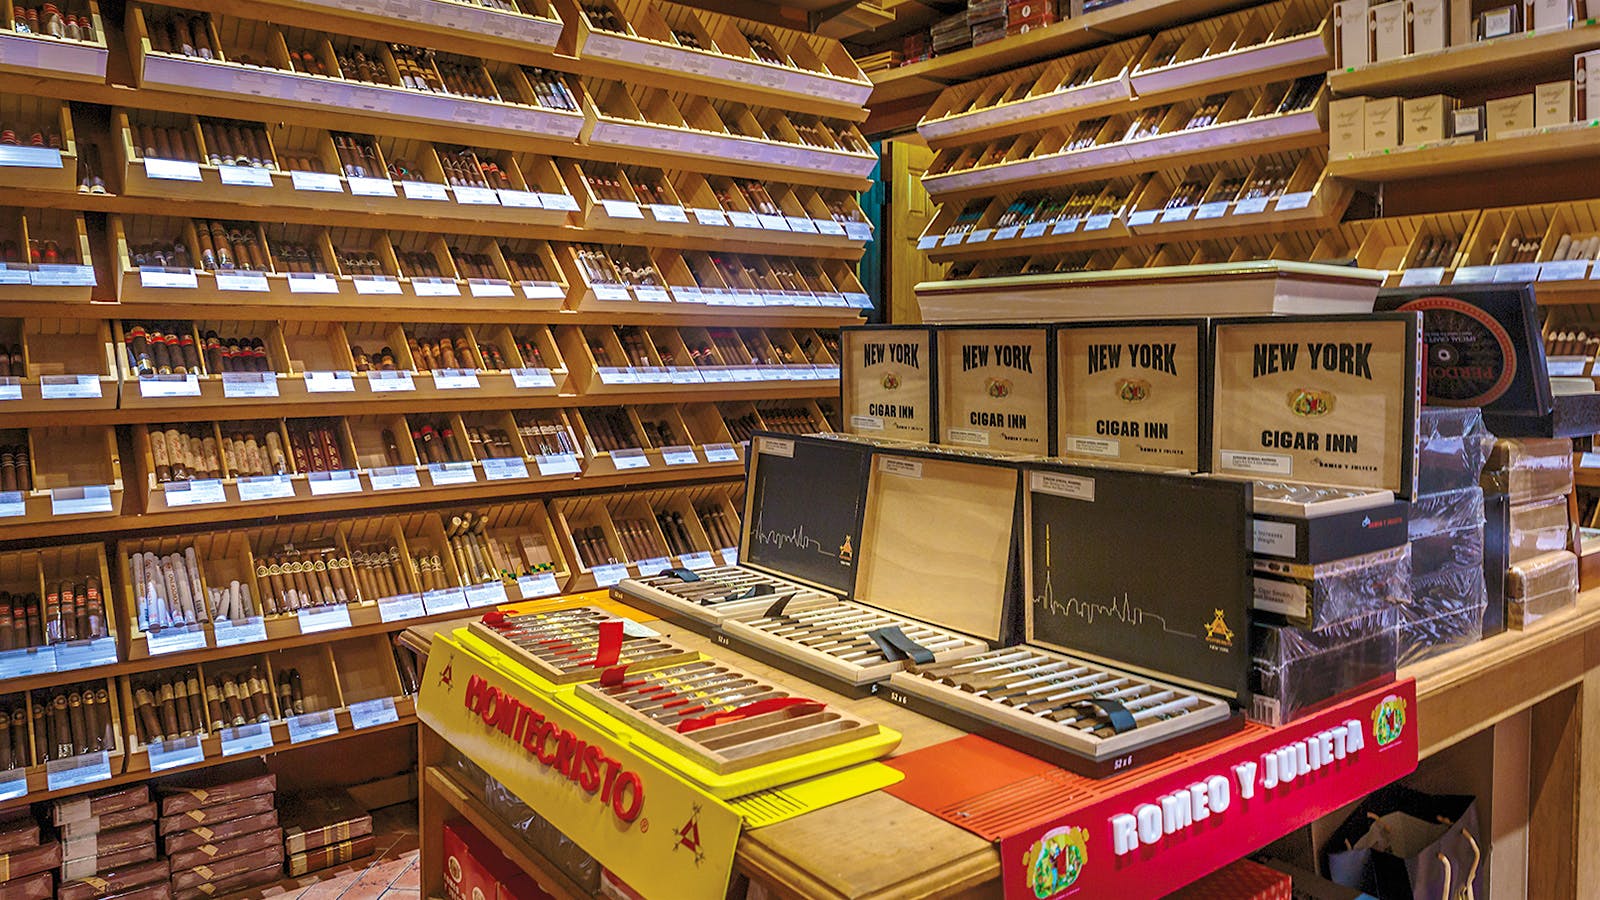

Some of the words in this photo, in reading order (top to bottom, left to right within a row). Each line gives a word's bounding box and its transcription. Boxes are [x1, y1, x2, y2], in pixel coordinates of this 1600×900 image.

[864, 343, 885, 368] NEW
[889, 343, 919, 369] YORK
[962, 344, 989, 372] NEW
[994, 344, 1032, 374] YORK
[1088, 344, 1121, 375] NEW
[1128, 343, 1177, 376] YORK
[1253, 343, 1298, 379] NEW
[1307, 343, 1372, 380] YORK
[1427, 366, 1493, 379] PERDO
[869, 403, 896, 418] CIGAR
[899, 405, 914, 419] INN
[970, 411, 1004, 428] CIGAR
[1007, 414, 1027, 429] INN
[1096, 420, 1139, 438] CIGAR
[1144, 422, 1168, 439] INN
[1261, 430, 1319, 451] CIGAR
[1325, 433, 1358, 454] INN
[464, 673, 644, 823] MONTECRISTO
[1111, 774, 1230, 856] ROMEO
[1235, 761, 1257, 800] Y
[1260, 719, 1365, 790] JULIETA
